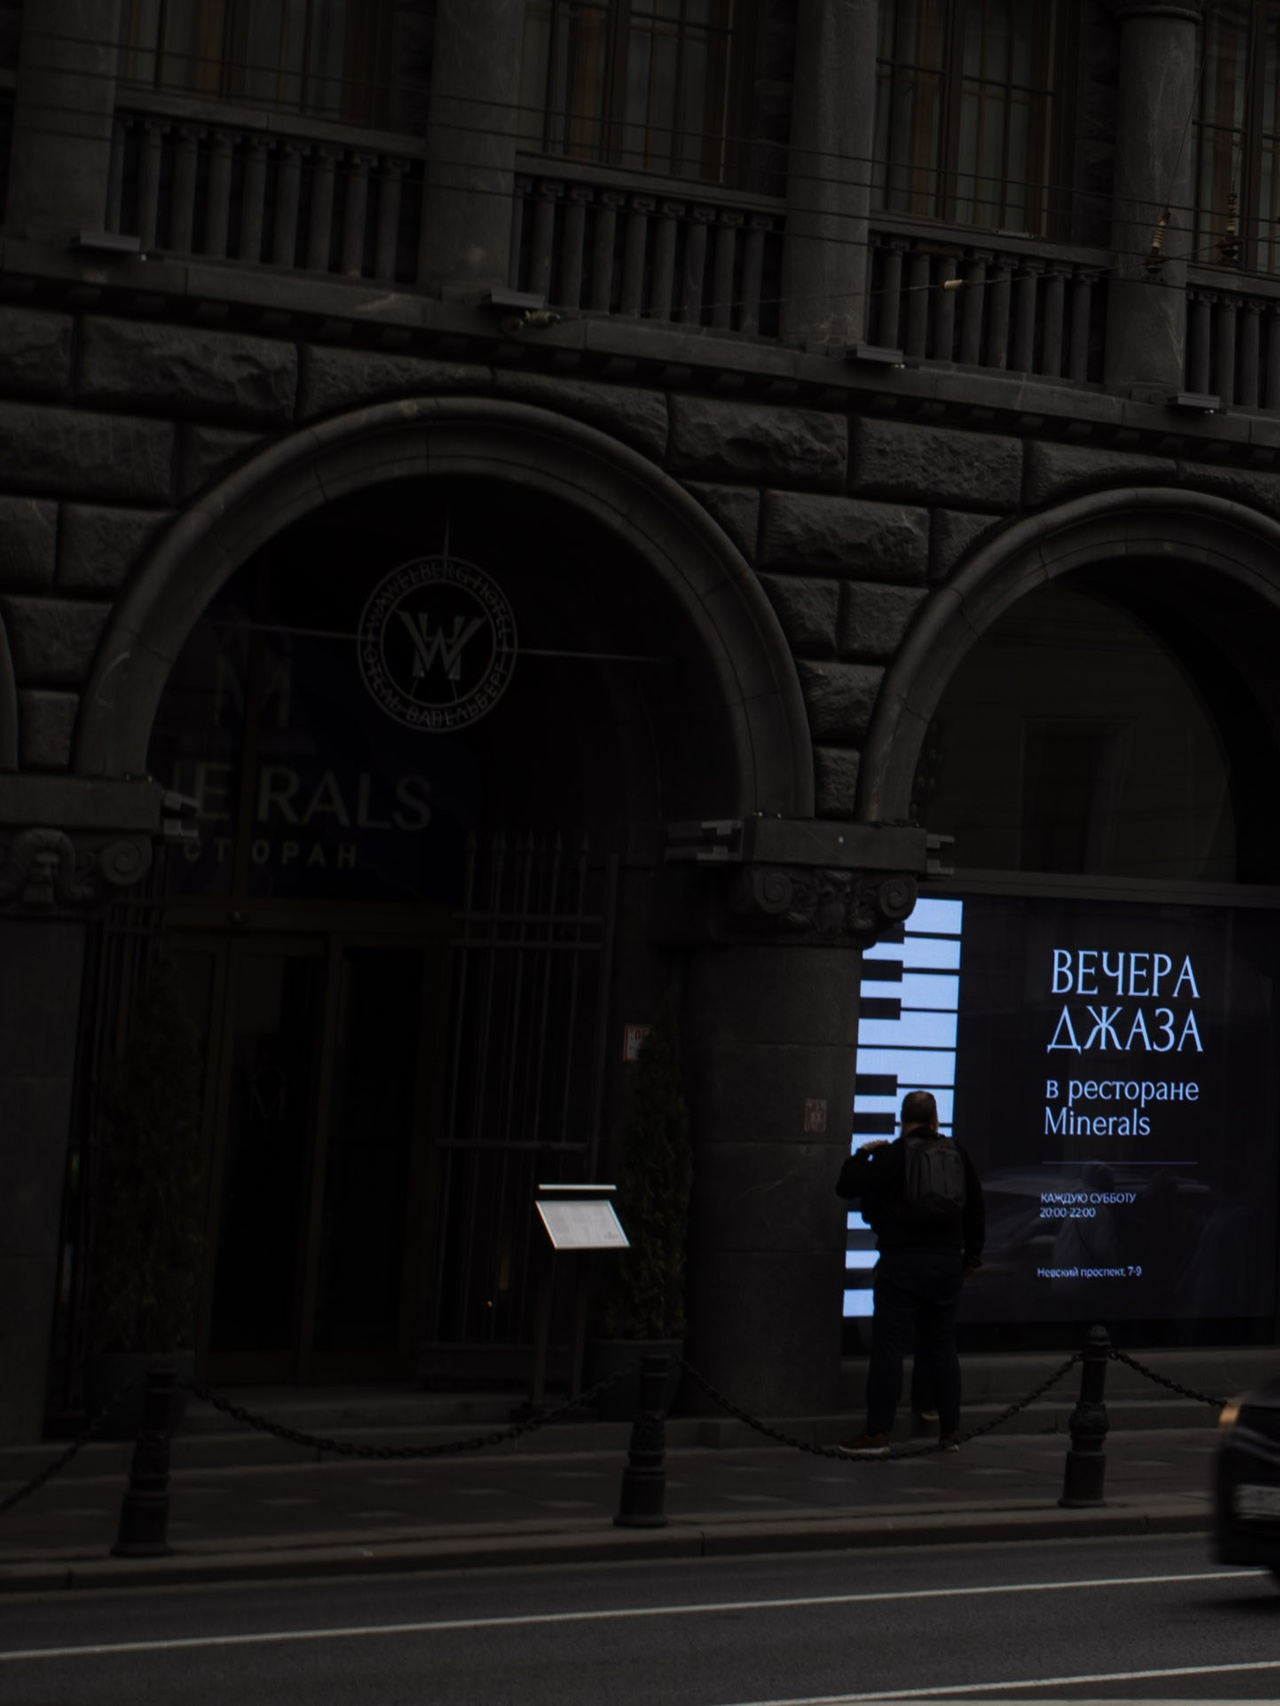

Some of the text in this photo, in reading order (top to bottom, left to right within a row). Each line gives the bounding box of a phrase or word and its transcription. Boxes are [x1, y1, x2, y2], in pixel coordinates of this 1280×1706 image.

[472, 576, 512, 639] HOTEL
[1051, 949, 1200, 998] ВЕЧЕРА
[1047, 1005, 1203, 1055] ДЖАЗА
[1046, 1080, 1199, 1108] в ресторане
[1045, 1106, 1151, 1136] Minerals
[1041, 1192, 1137, 1205] КАЖДУЮ СУББОТУ
[1037, 1266, 1079, 1278] Невский
[1127, 1265, 1142, 1277] 7-9
